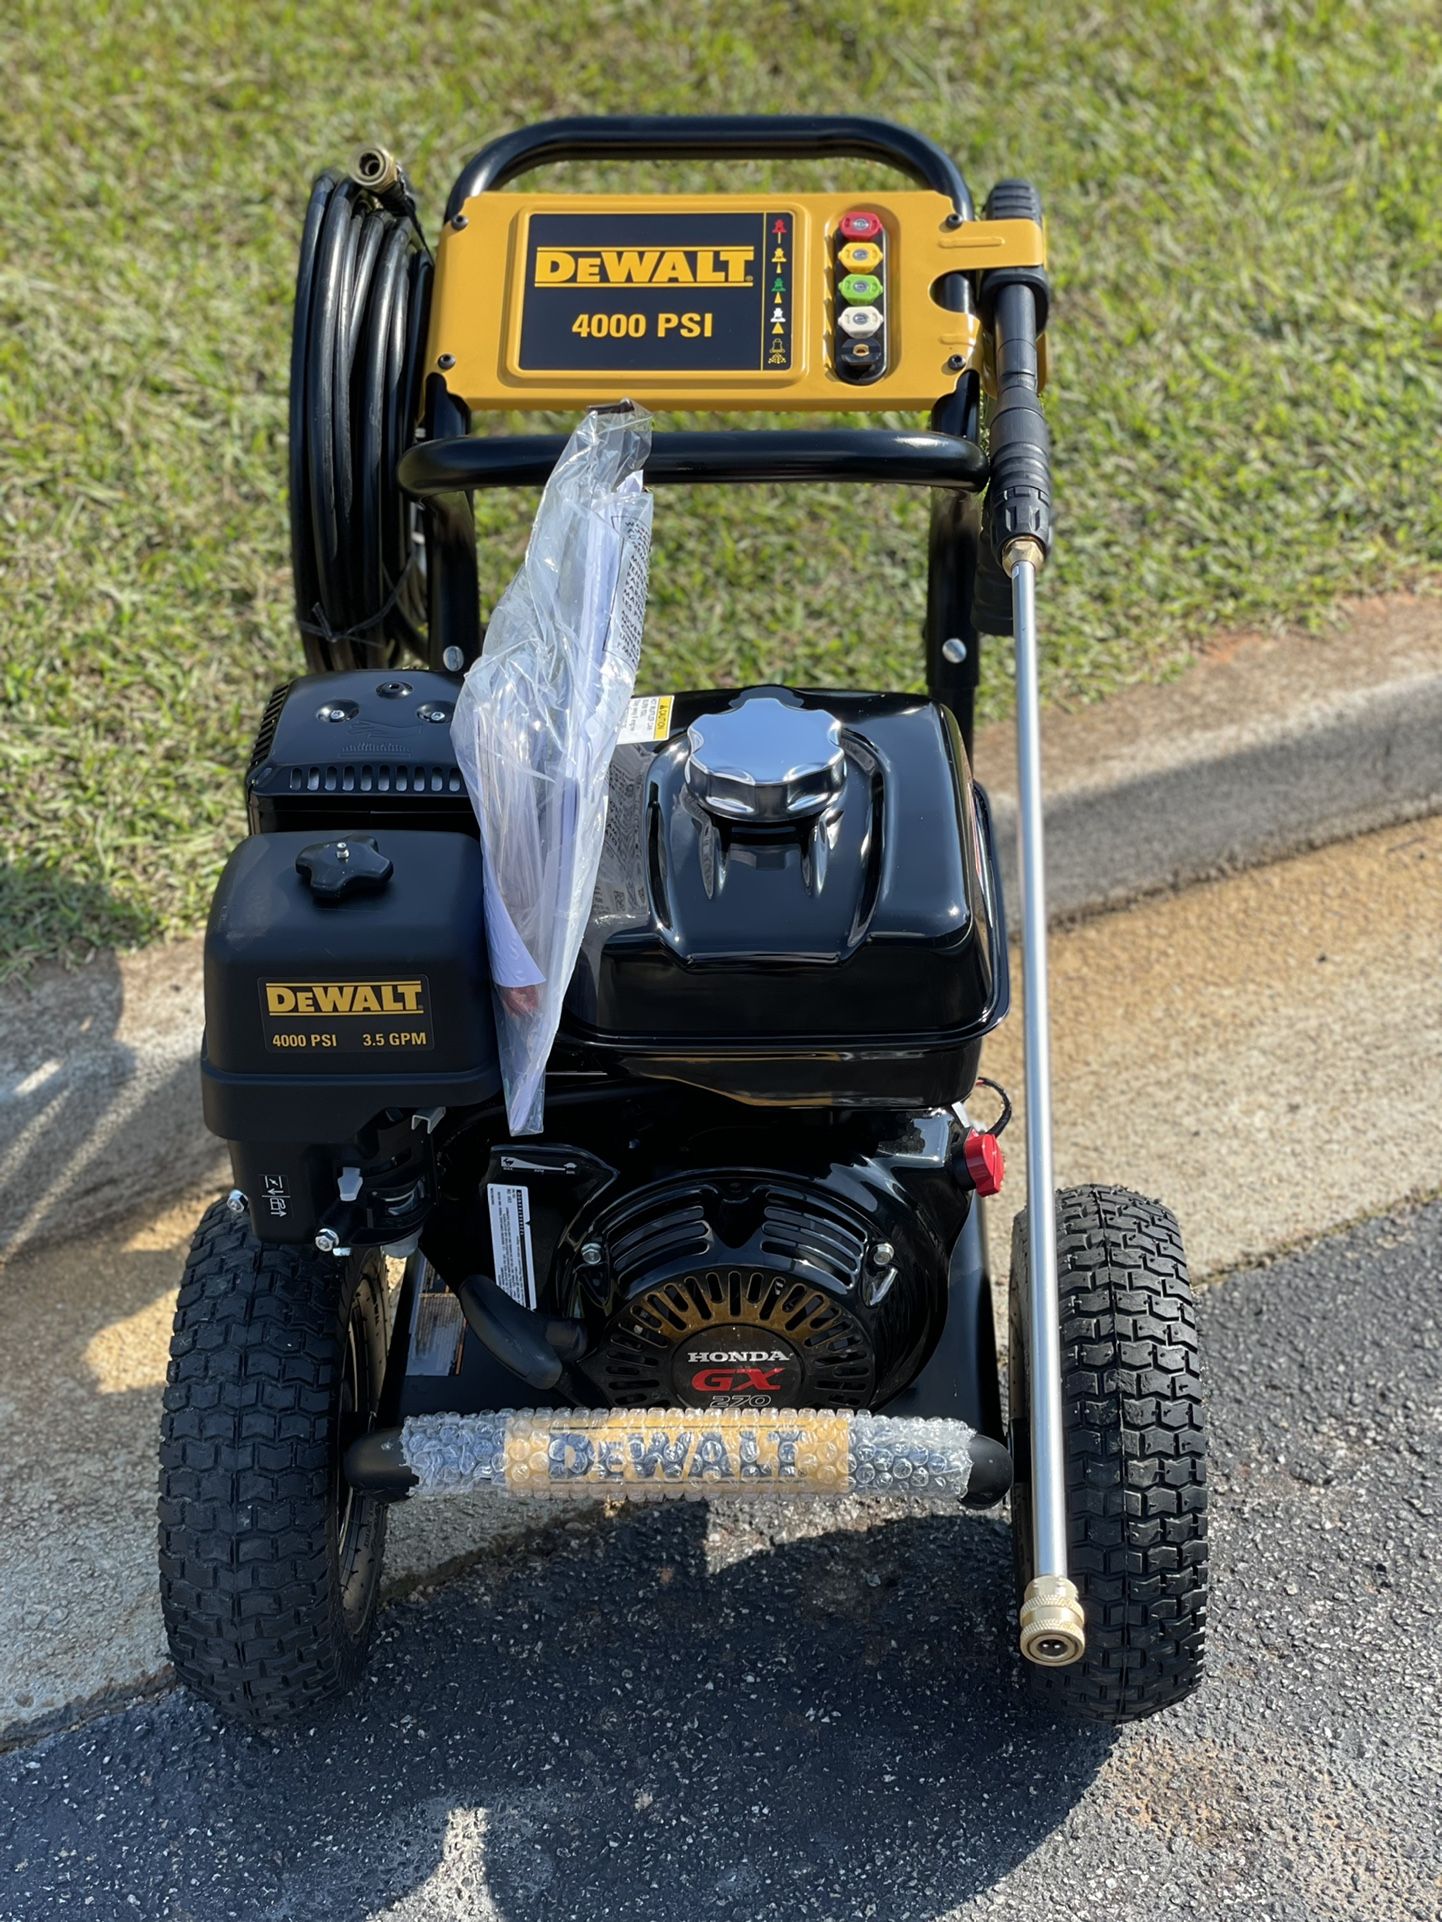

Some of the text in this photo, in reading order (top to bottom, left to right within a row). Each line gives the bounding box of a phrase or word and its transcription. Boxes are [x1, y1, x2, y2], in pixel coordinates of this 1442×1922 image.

[571, 312, 713, 338] 4000 PSI
[272, 1032, 427, 1047] 4000 PSI 3.5 GPM
[687, 1350, 790, 1363] HONDA
[691, 1367, 785, 1392] GX
[709, 1394, 772, 1408] 270
